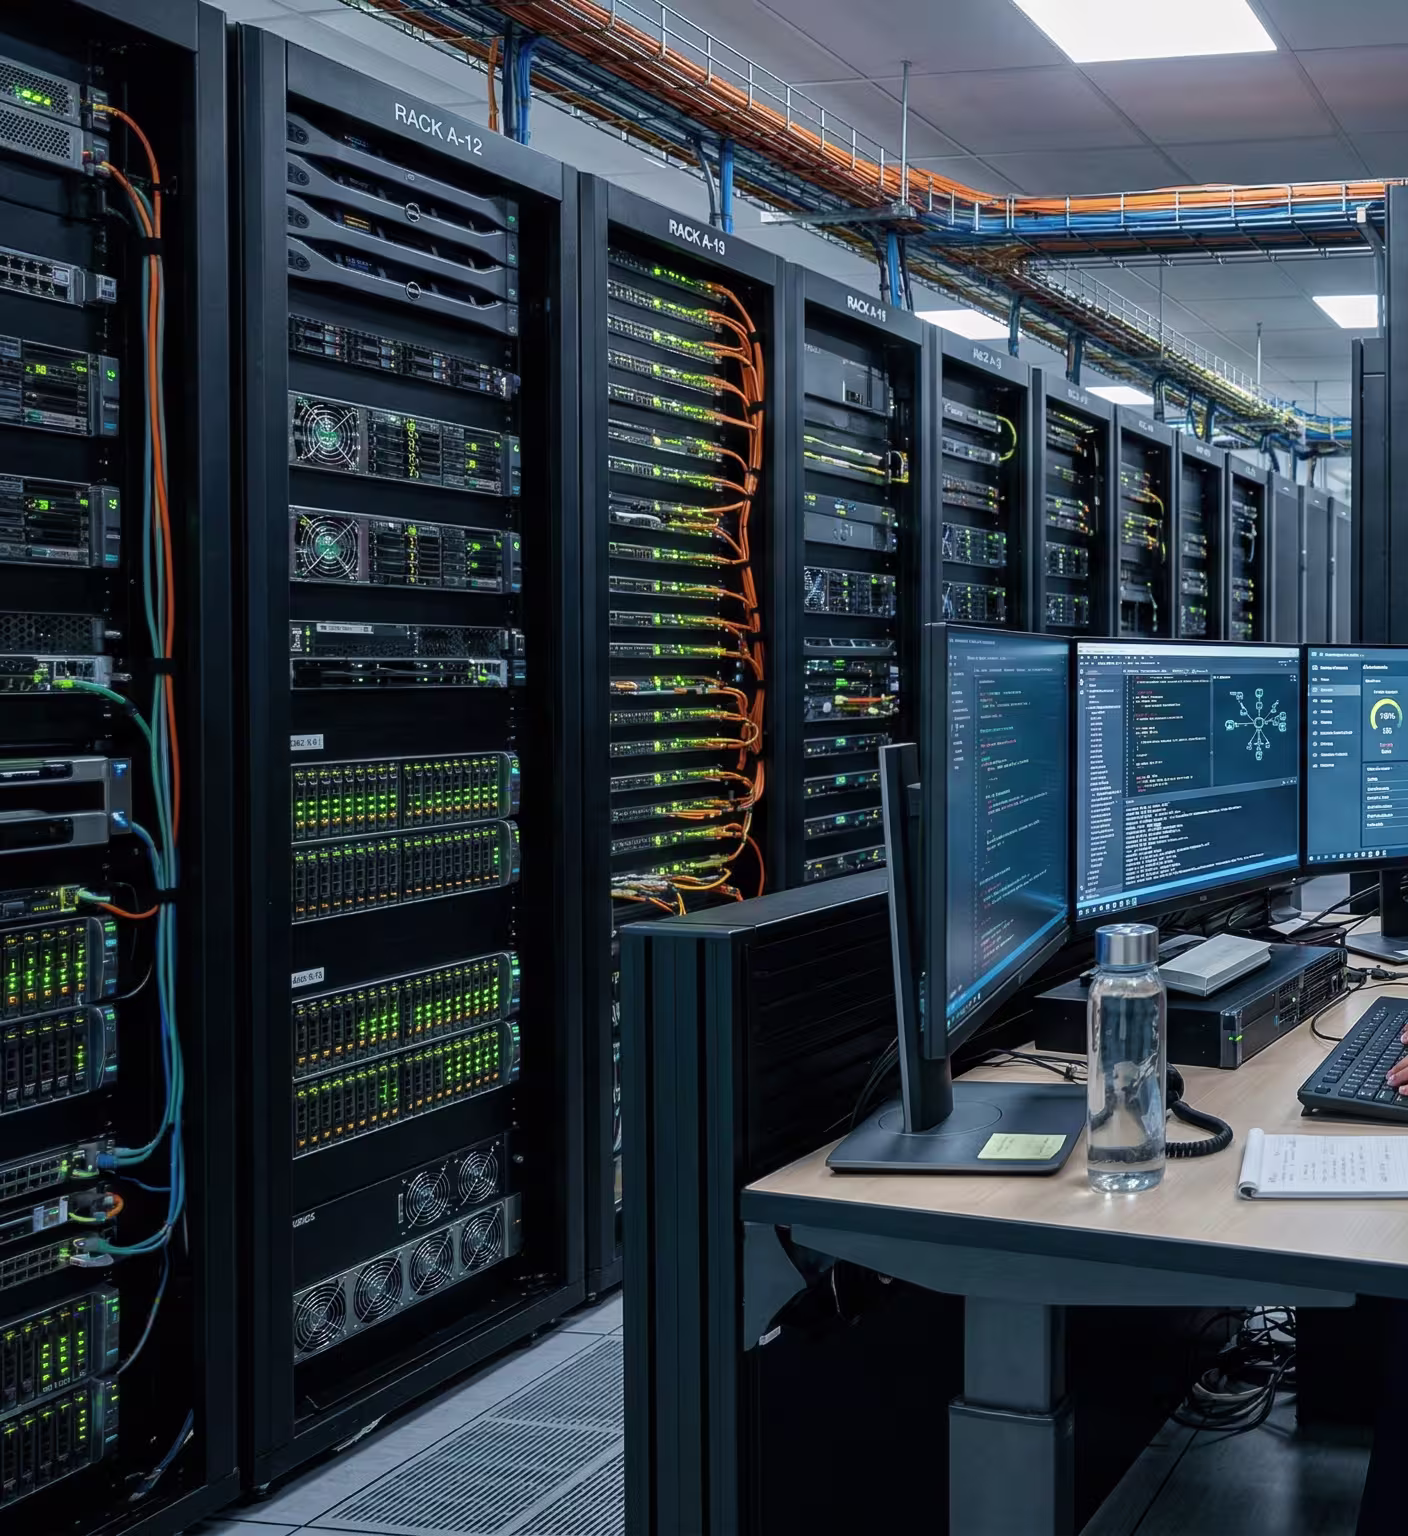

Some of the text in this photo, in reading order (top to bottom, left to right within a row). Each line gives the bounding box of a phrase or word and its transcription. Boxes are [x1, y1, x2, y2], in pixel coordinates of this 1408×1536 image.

[394, 102, 483, 156] RACK A-12
[669, 218, 725, 256] RACK A-19
[847, 295, 870, 316] RACK
